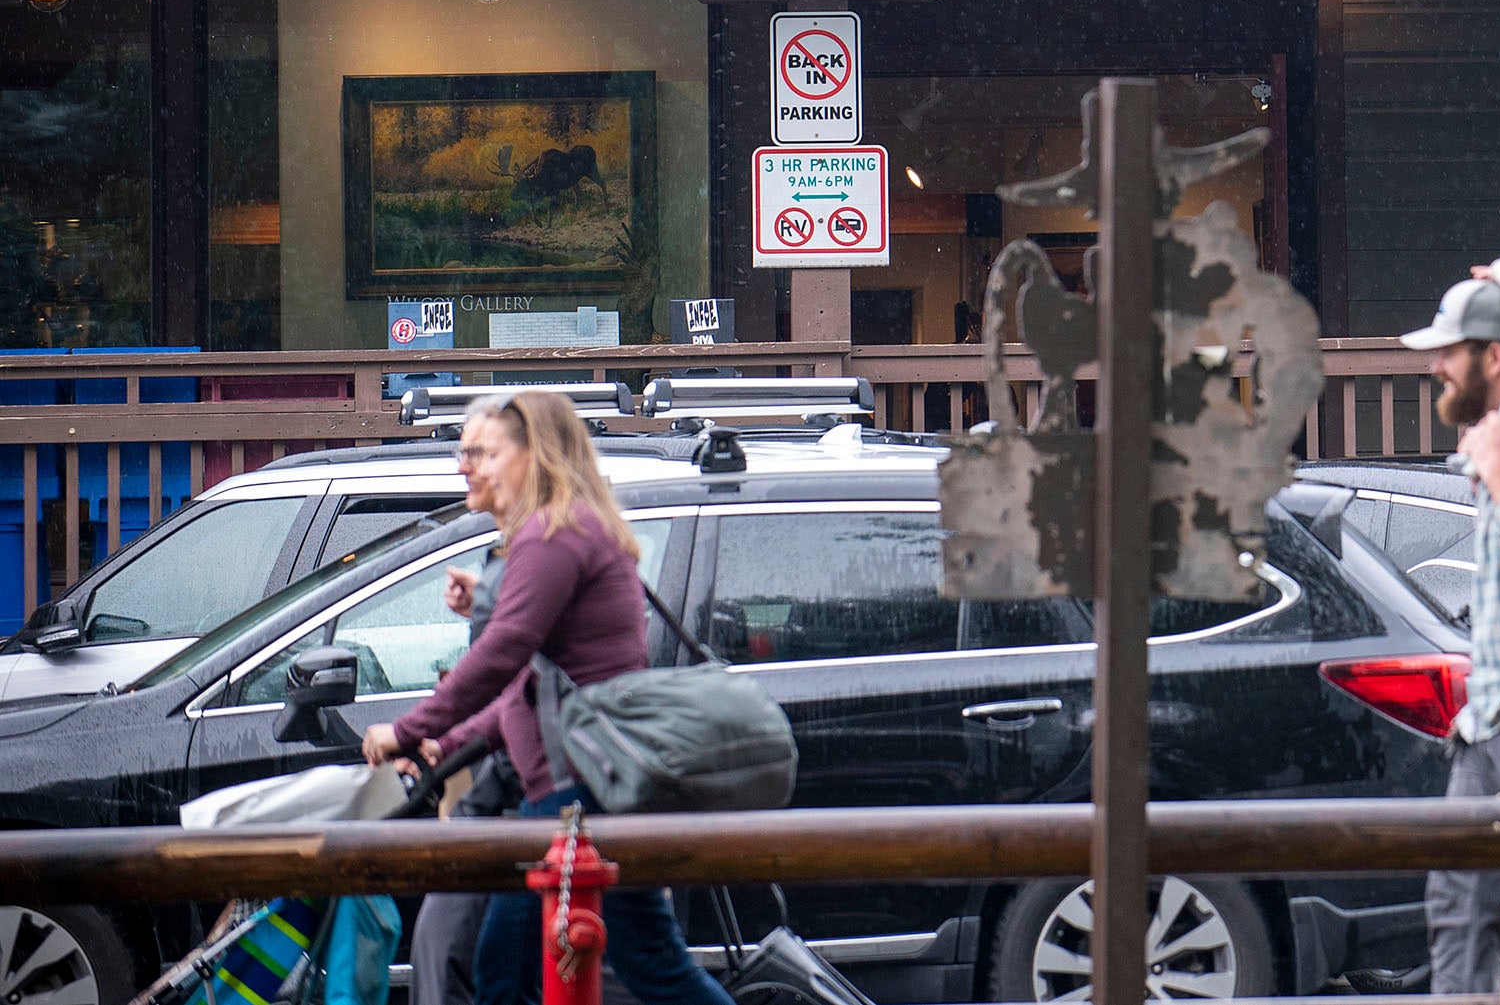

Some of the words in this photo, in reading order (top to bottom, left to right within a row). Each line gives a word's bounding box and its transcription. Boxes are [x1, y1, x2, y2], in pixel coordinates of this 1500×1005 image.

[787, 53, 845, 69] BACK
[805, 70, 827, 85] IN
[780, 105, 853, 121] PARKING
[764, 159, 774, 173] 3
[782, 158, 802, 172] HR
[810, 157, 876, 172] PARKING
[780, 218, 807, 237] RV
[460, 294, 534, 312] GALLERY
